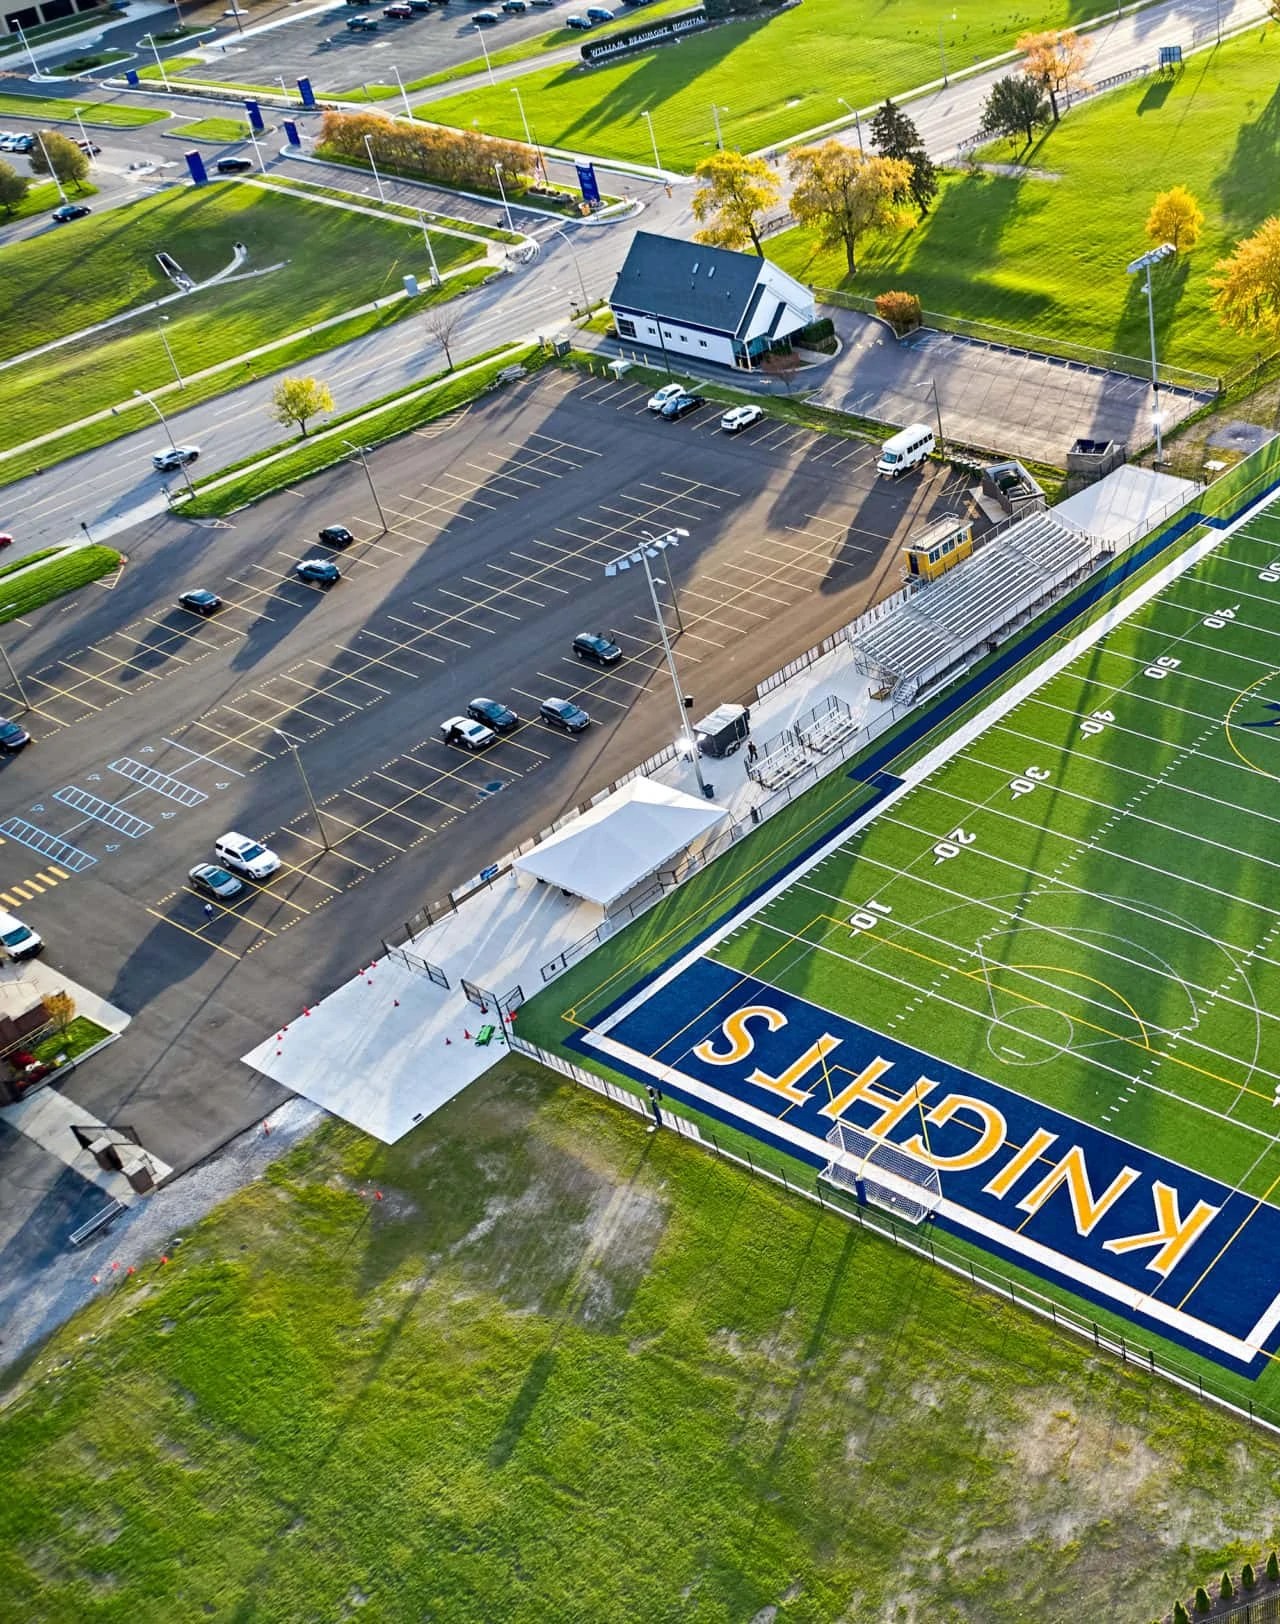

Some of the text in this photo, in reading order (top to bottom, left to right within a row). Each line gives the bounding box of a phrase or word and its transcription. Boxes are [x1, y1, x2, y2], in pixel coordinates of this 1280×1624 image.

[590, 40, 626, 57] WILLIAM
[1203, 608, 1236, 629] 40
[1143, 656, 1182, 680] 50
[1079, 710, 1116, 734] 40
[1009, 766, 1051, 794] 30
[933, 827, 977, 859] 20
[850, 900, 893, 930] 10
[693, 1006, 1221, 1279] KNIGHTS
